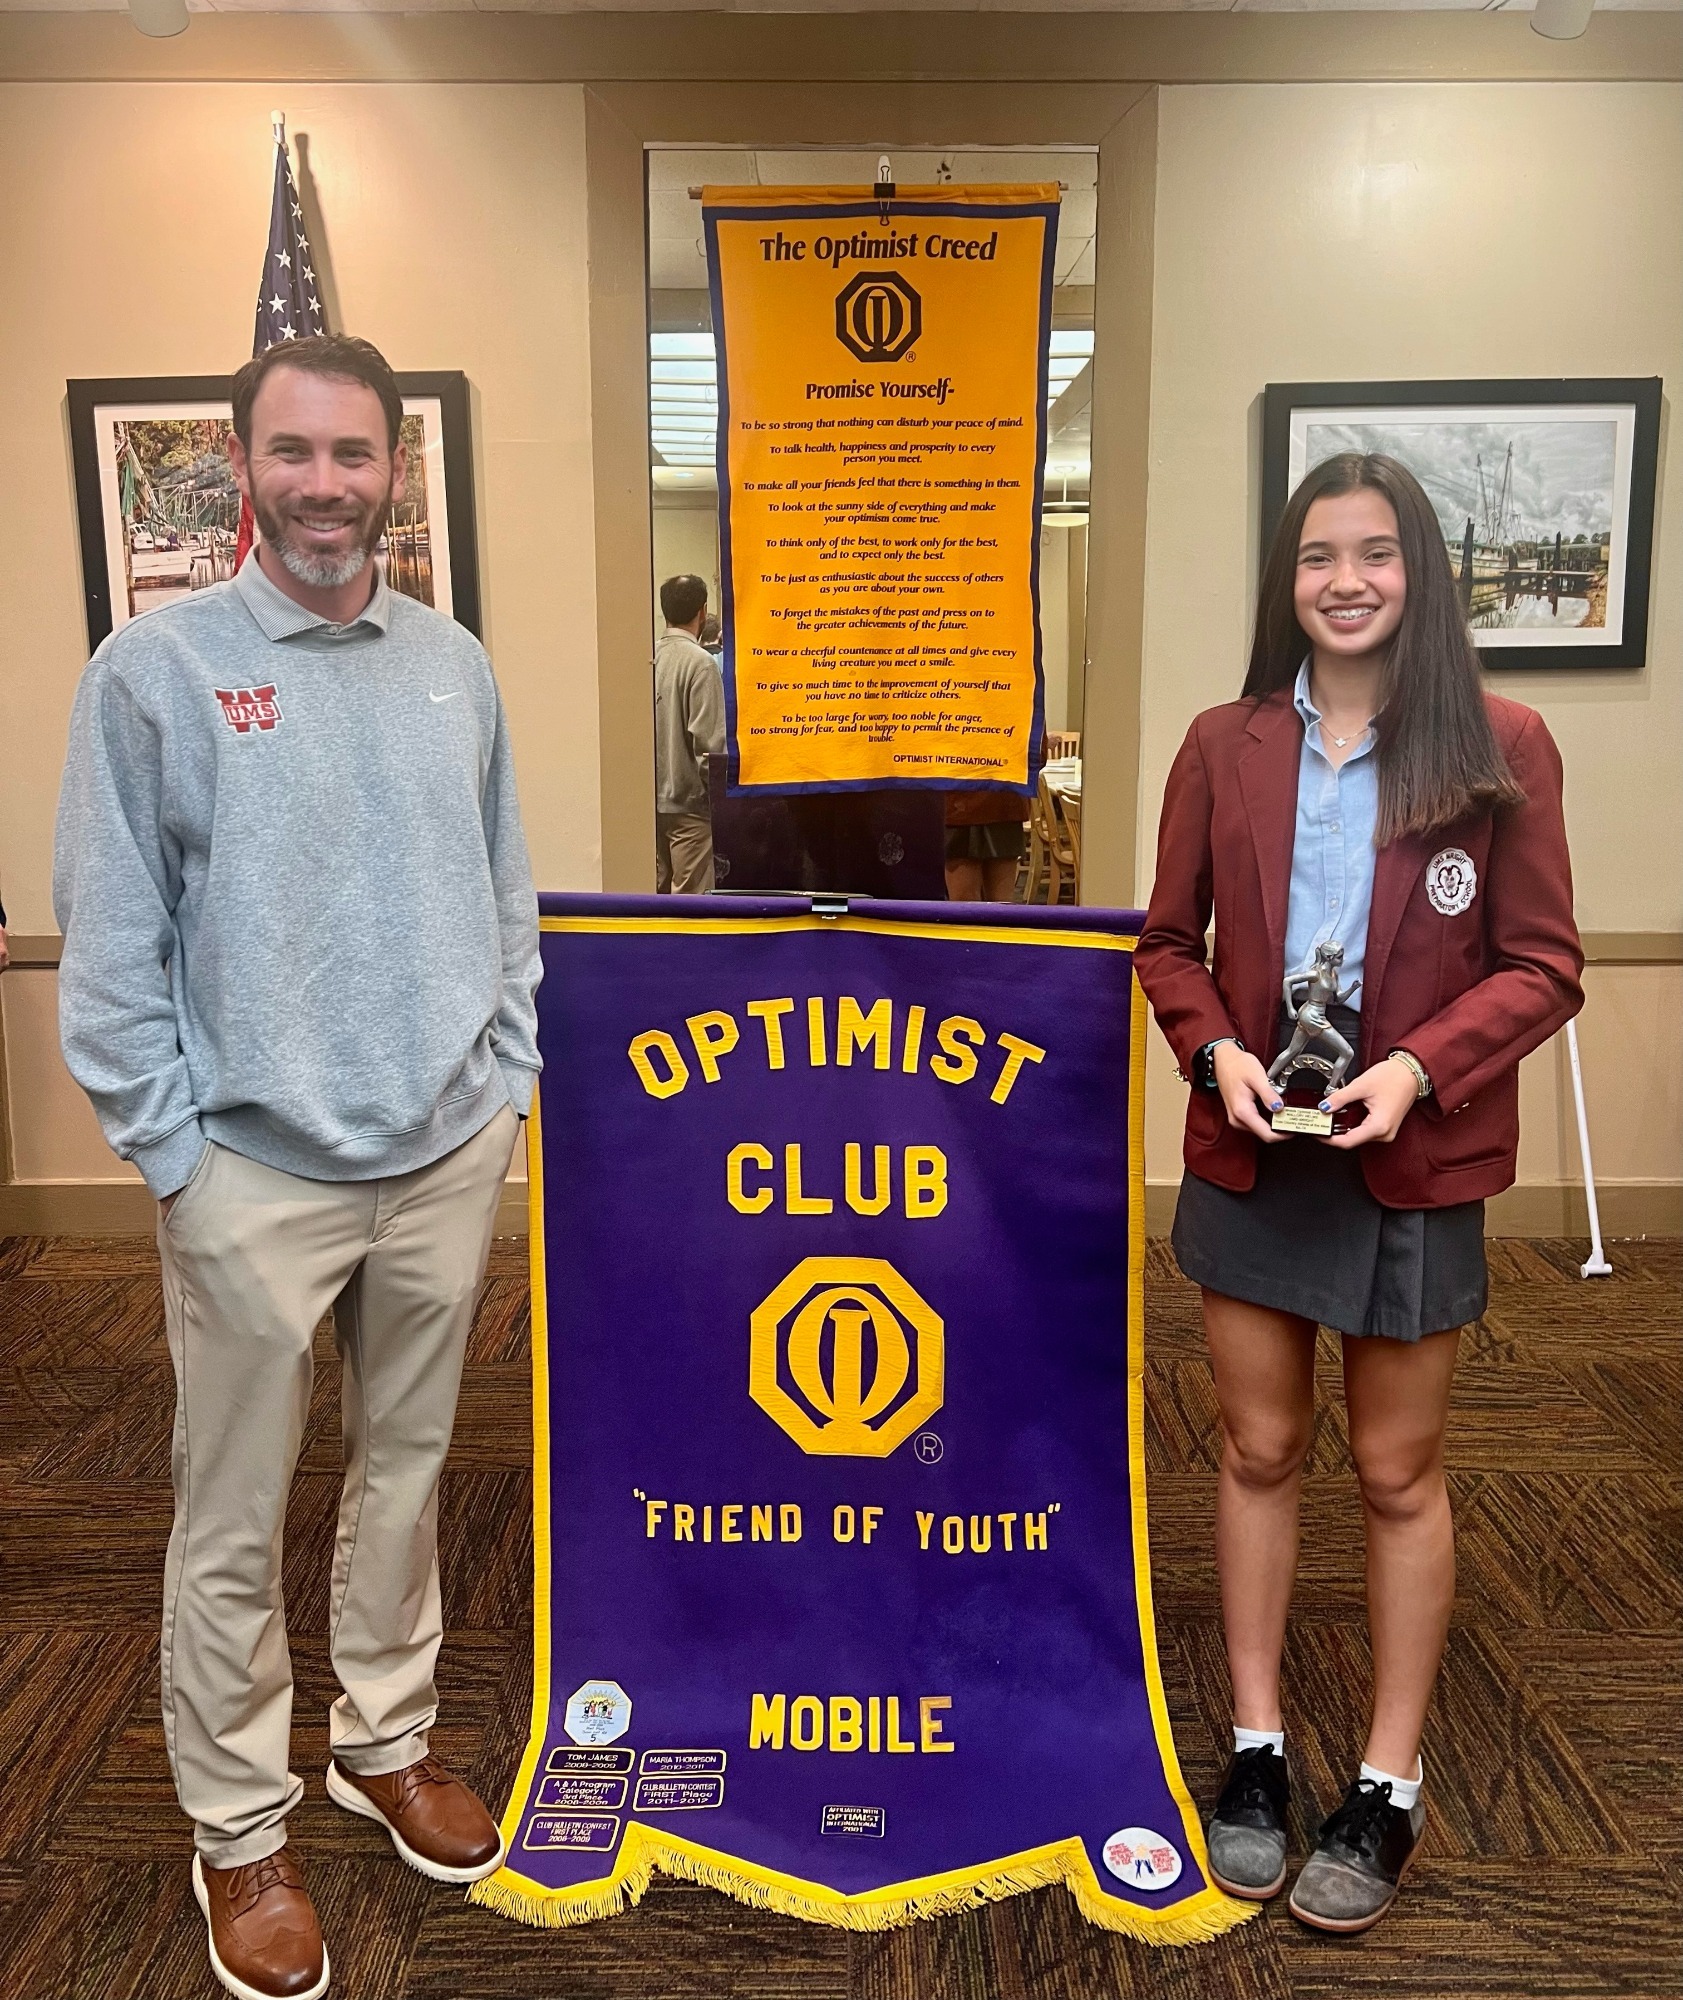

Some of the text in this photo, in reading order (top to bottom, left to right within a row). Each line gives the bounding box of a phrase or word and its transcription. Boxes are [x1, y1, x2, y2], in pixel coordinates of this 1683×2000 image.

[760, 230, 997, 268] The Optimist Creed
[806, 377, 954, 404] Promise Yourself-
[754, 420, 766, 429] be
[783, 421, 813, 431] strong
[816, 418, 835, 427] that
[837, 417, 873, 428] nothing
[896, 417, 929, 426] disturb
[931, 420, 953, 429] your
[955, 420, 983, 430] peace
[985, 417, 996, 430] of
[998, 416, 1023, 426] mind.
[784, 443, 801, 453] talk
[804, 442, 836, 452] health,
[839, 441, 886, 453] happiness
[889, 441, 907, 450] and
[909, 442, 955, 455] prosperity
[958, 443, 968, 451] to
[970, 445, 995, 454] every
[843, 452, 921, 465] person you meet.
[743, 476, 1020, 491] To make all your friends feel that there is something in them.
[768, 500, 996, 515] To look at the sunny side of everything and make
[824, 515, 845, 525] your
[847, 511, 889, 524] optimism
[919, 512, 942, 522] true.
[779, 537, 803, 546] think
[806, 537, 826, 549] only
[828, 536, 839, 551] of
[841, 536, 855, 545] the
[858, 536, 879, 546] best,
[882, 538, 891, 546] to
[894, 537, 917, 548] work
[920, 537, 940, 551] only
[941, 537, 956, 549] for
[959, 537, 973, 546] the
[976, 537, 997, 547] best,
[819, 548, 837, 559] and
[852, 551, 881, 560] expect
[883, 550, 903, 562] only
[906, 550, 920, 559] the
[923, 549, 944, 559] best.
[761, 574, 771, 582] To
[774, 573, 785, 582] be
[788, 574, 805, 584] just
[822, 572, 875, 581] enthusiastic
[876, 572, 904, 582] about
[907, 572, 921, 581] the
[962, 572, 973, 584] of
[974, 573, 1003, 582] others
[832, 586, 849, 595] you
[870, 583, 895, 592] about
[897, 586, 919, 595] your
[770, 609, 781, 617] To
[783, 608, 811, 621] forget
[814, 607, 827, 616] the
[830, 606, 869, 616] mistakes
[872, 606, 882, 618] of
[882, 606, 896, 615] the
[898, 608, 919, 618] past
[921, 607, 940, 618] and
[940, 610, 966, 621] press
[797, 617, 967, 632] the greater achievements of the future.
[226, 704, 275, 722] UMS
[893, 754, 932, 762] OPTIMIST
[628, 996, 1047, 1105] OPTIMIST
[726, 1142, 948, 1219] CLUB
[833, 1504, 884, 1545] OF
[749, 1693, 955, 1753] MOBILE
[590, 1733, 597, 1743] 5
[567, 1753, 586, 1761] TOM
[579, 1781, 616, 1789] Program
[641, 1783, 658, 1791] CLUB
[826, 1813, 880, 1822] OPTIMIST
[536, 1821, 553, 1829] CLUB
